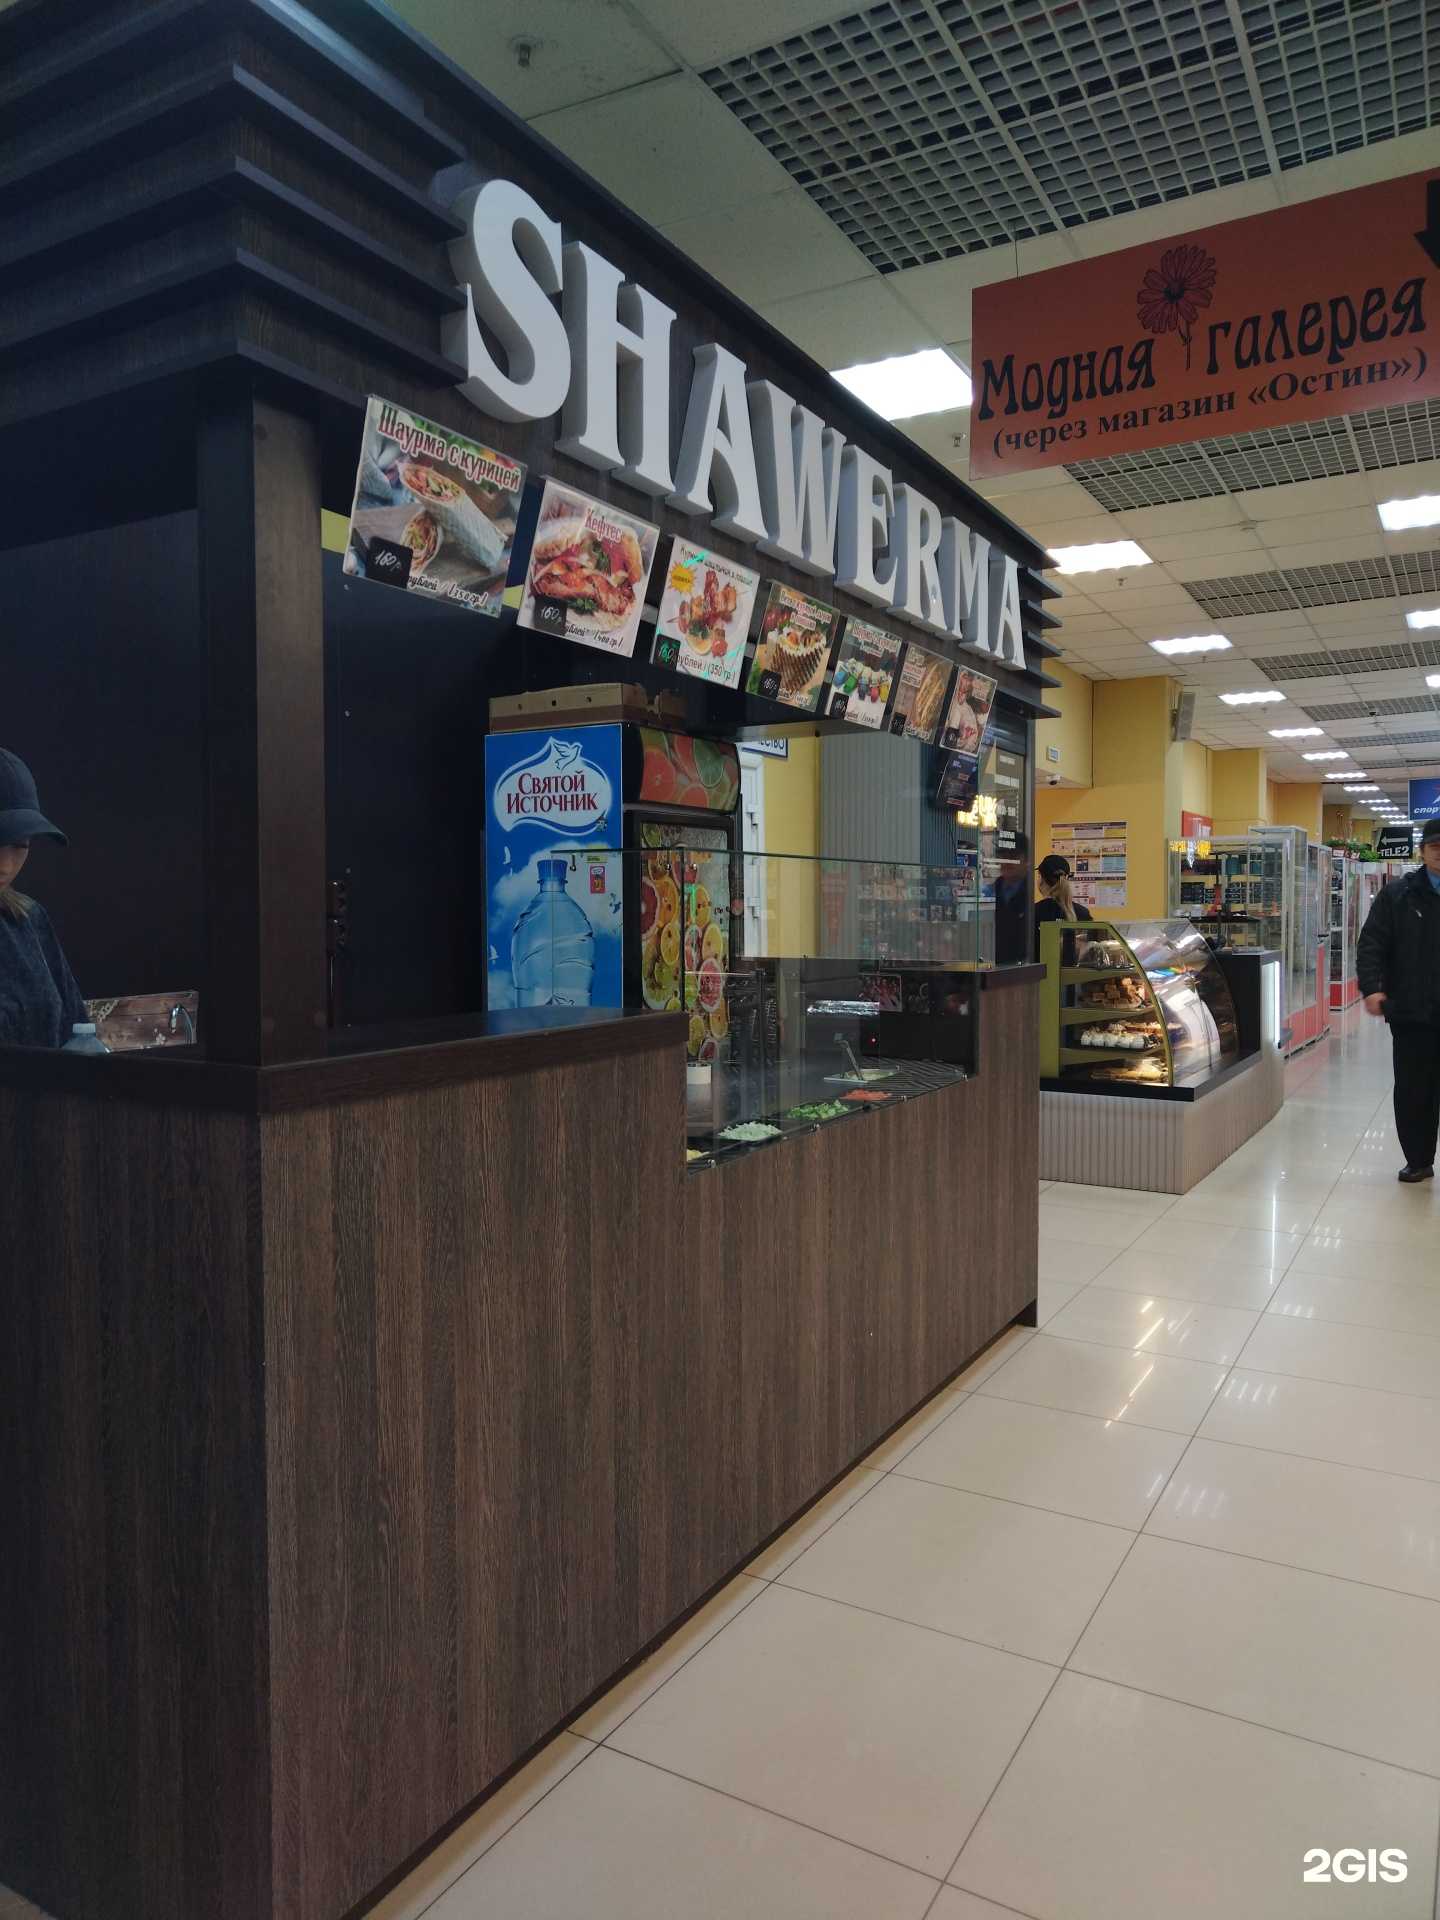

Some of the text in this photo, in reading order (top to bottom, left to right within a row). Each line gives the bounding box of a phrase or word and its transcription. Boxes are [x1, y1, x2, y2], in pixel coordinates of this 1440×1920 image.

[978, 277, 1427, 421] Модная галерея
[376, 404, 446, 459] Шаурма
[460, 449, 522, 492] курицей
[452, 178, 1027, 671] SHAWERMA
[993, 346, 1428, 460] (через магазин «Остин»)
[1380, 845, 1410, 857] TELE2
[1413, 807, 1440, 815] спор
